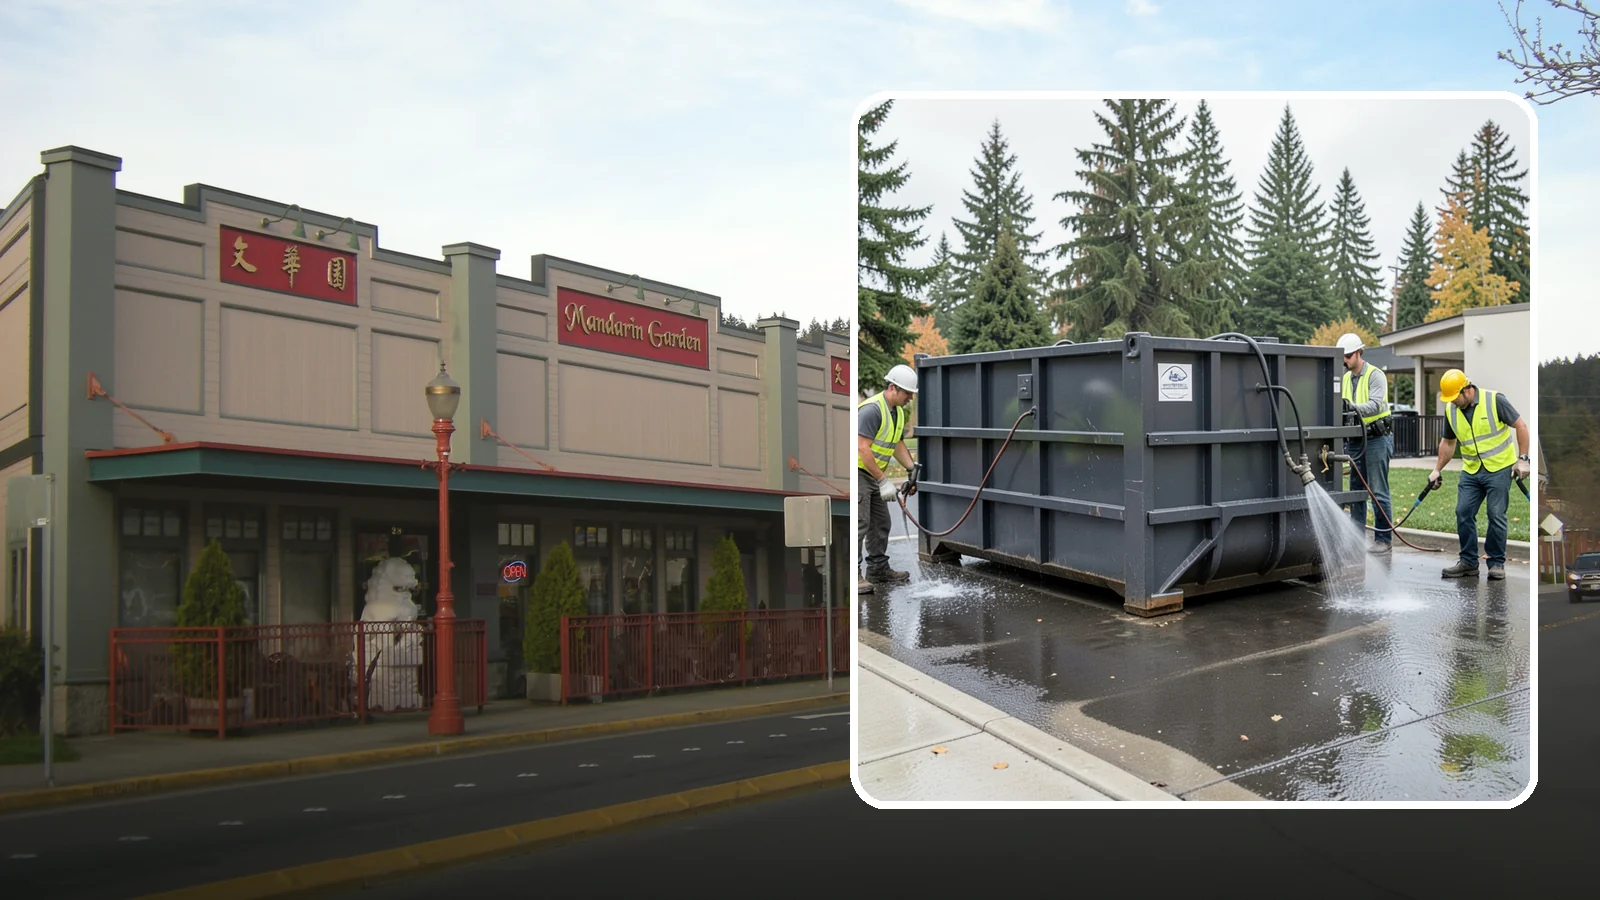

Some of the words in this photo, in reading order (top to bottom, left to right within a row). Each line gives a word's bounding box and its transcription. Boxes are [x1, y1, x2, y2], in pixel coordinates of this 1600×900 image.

[230, 235, 346, 291] 文華園
[564, 302, 644, 341] Mandarin
[647, 320, 702, 352] Garden
[503, 565, 527, 578] OPEN
